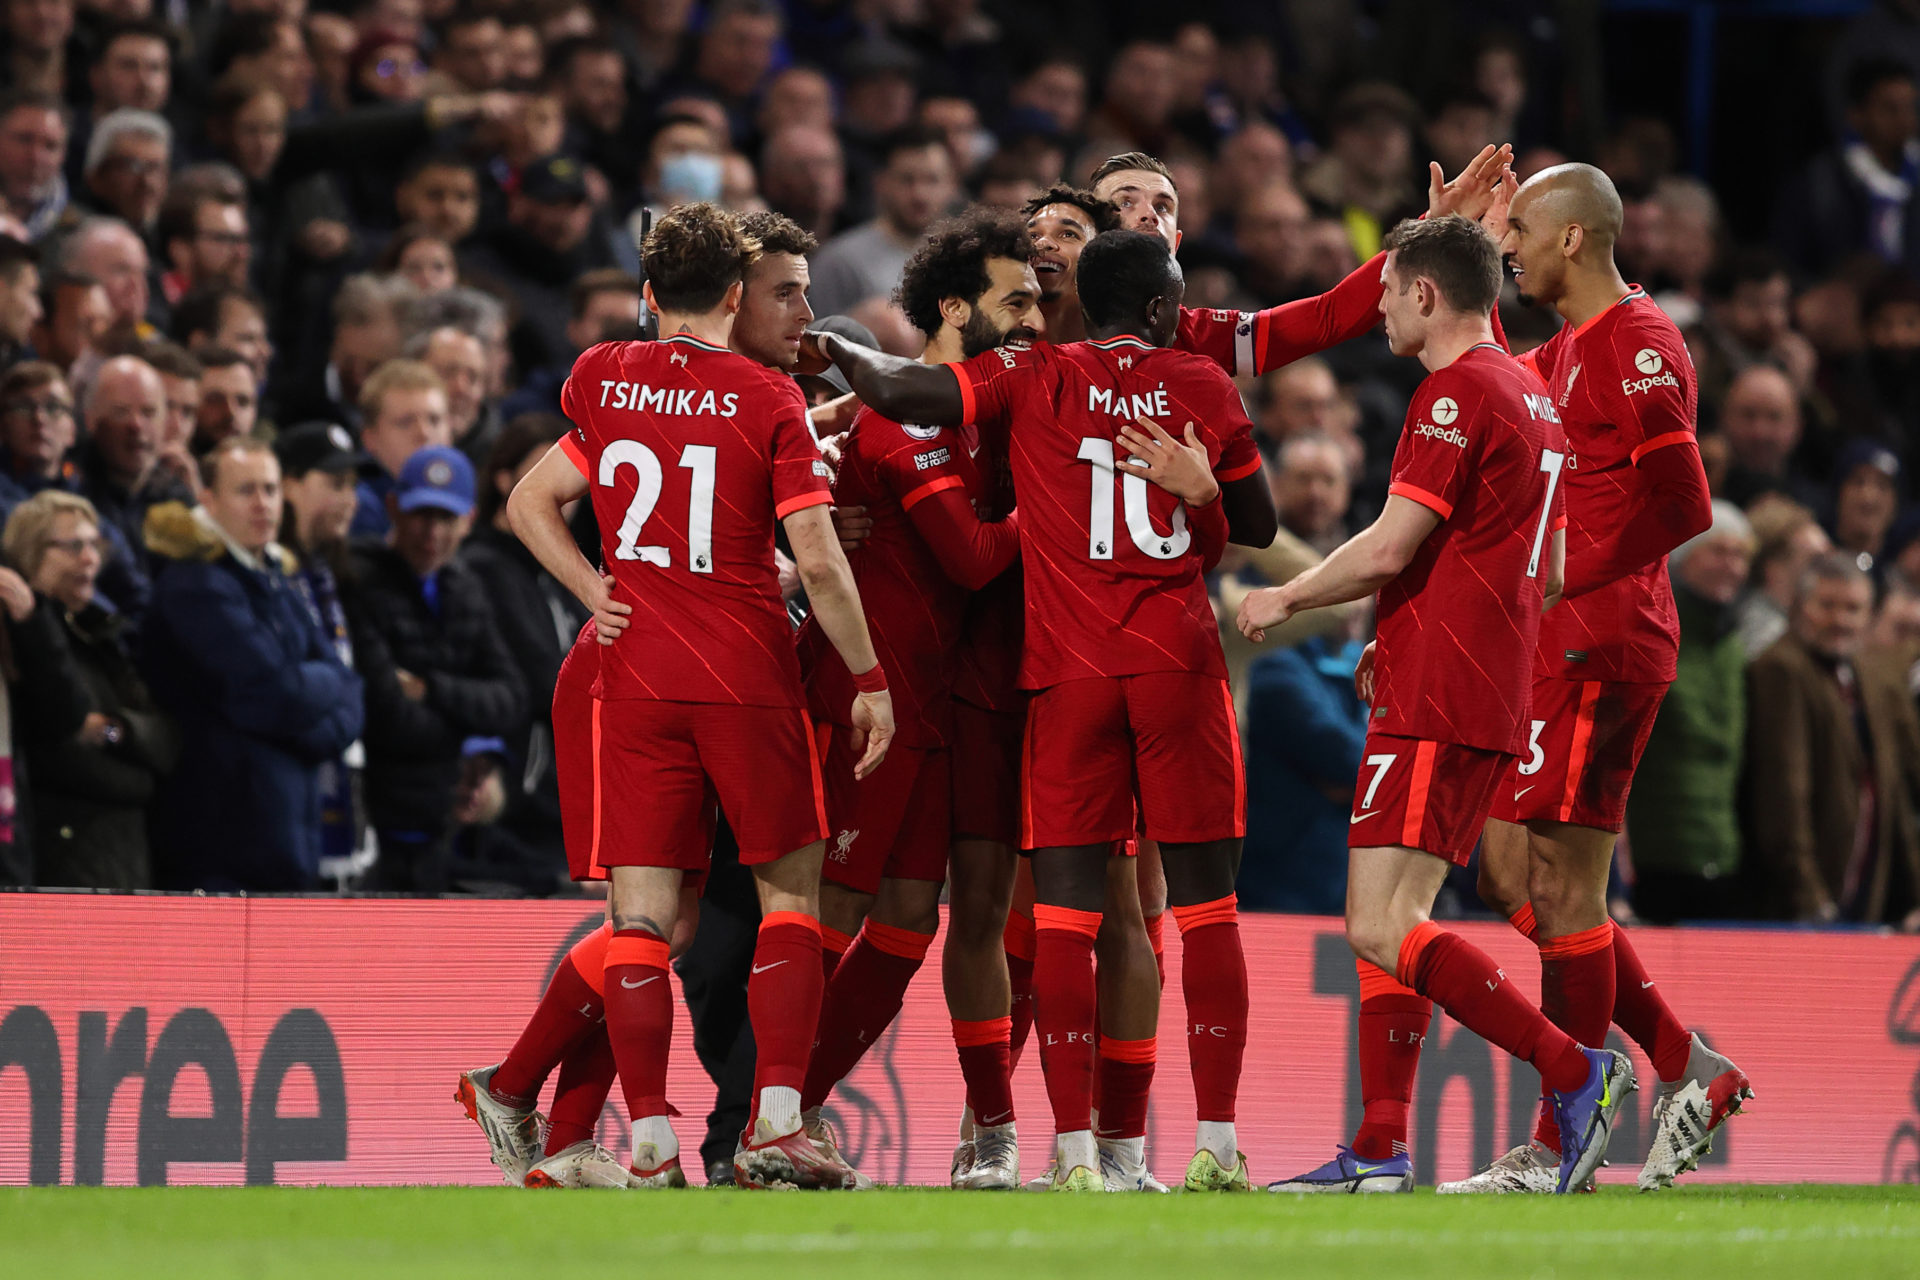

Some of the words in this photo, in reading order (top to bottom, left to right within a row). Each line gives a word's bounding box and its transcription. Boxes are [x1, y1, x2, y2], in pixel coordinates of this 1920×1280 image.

[600, 380, 739, 417] TSIMIKAS
[1088, 382, 1171, 420] MANÉ
[1523, 393, 1562, 424] MILNE
[914, 453, 928, 463] No
[916, 460, 929, 471] for
[599, 439, 717, 573] 21
[1077, 437, 1191, 560] 10
[1526, 449, 1564, 578] 7
[1517, 720, 1547, 775] 3
[1361, 754, 1398, 809] 7
[1187, 1024, 1227, 1038] FC
